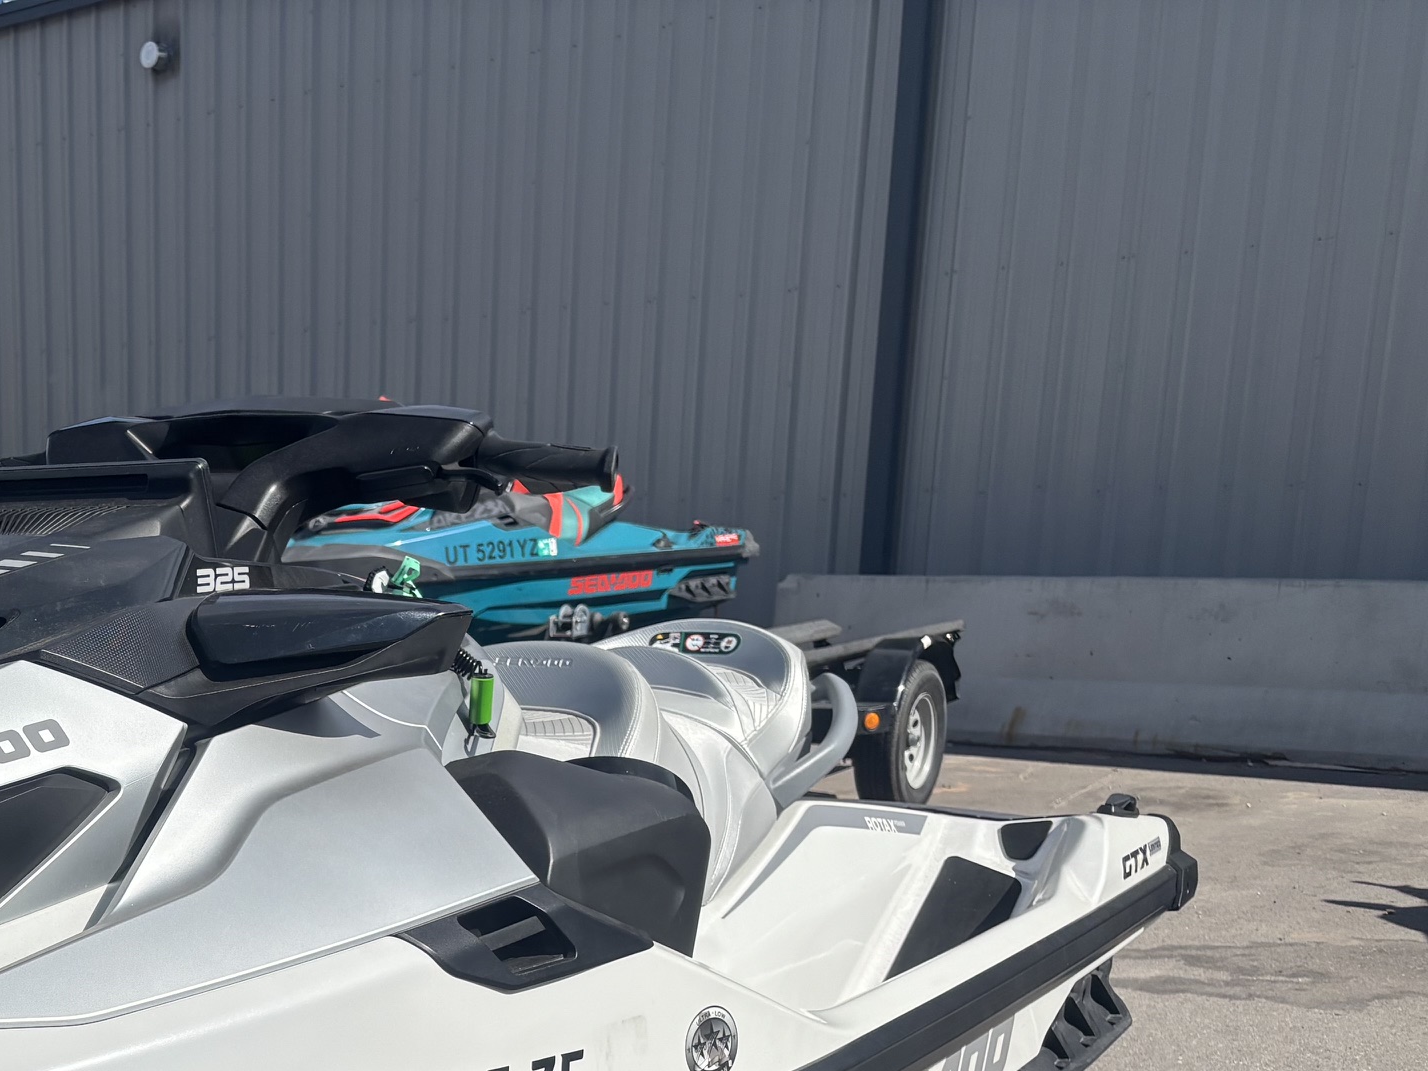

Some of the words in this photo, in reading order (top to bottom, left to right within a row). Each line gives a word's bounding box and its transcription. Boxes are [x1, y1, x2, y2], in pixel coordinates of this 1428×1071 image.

[445, 544, 471, 565] UT
[196, 566, 251, 594] 325
[864, 816, 898, 833] ROTAX
[1122, 843, 1149, 880] GTX
